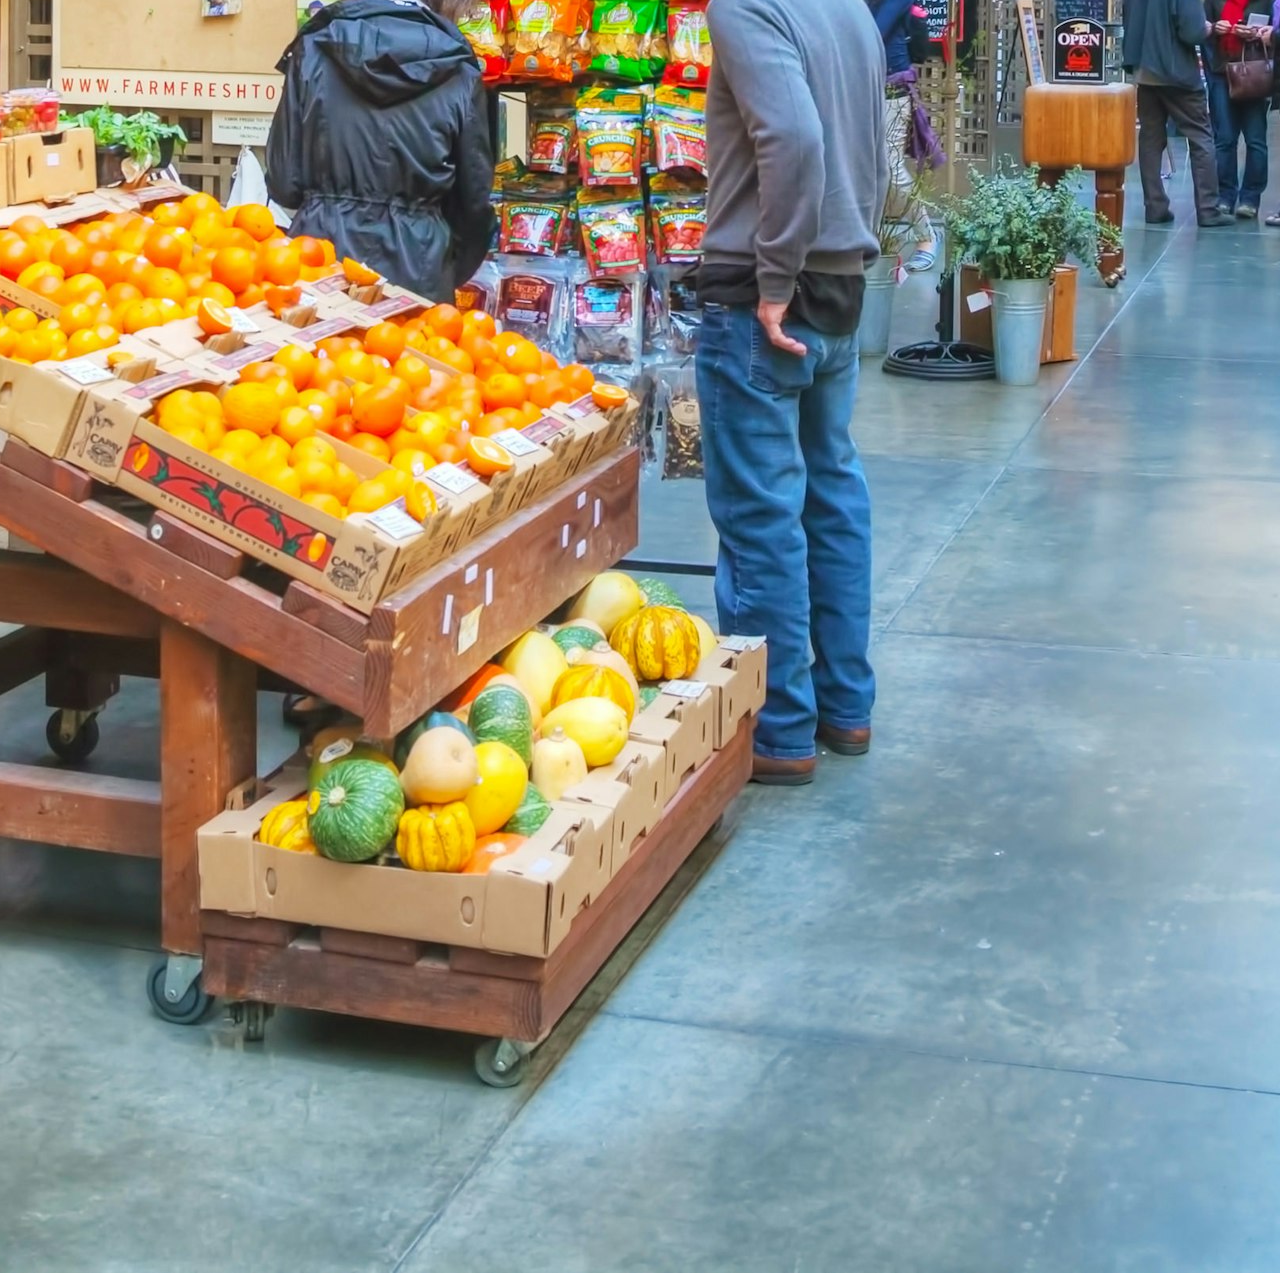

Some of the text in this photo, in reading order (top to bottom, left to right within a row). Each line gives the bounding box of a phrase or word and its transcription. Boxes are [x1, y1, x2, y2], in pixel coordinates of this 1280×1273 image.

[1058, 33, 1100, 46] OPEN
[61, 78, 284, 100] WWW.FARMFRESHTO
[185, 456, 285, 510] CAPAY ORGANIC
[160, 492, 280, 558] HEIRLOOM TOMATOES
